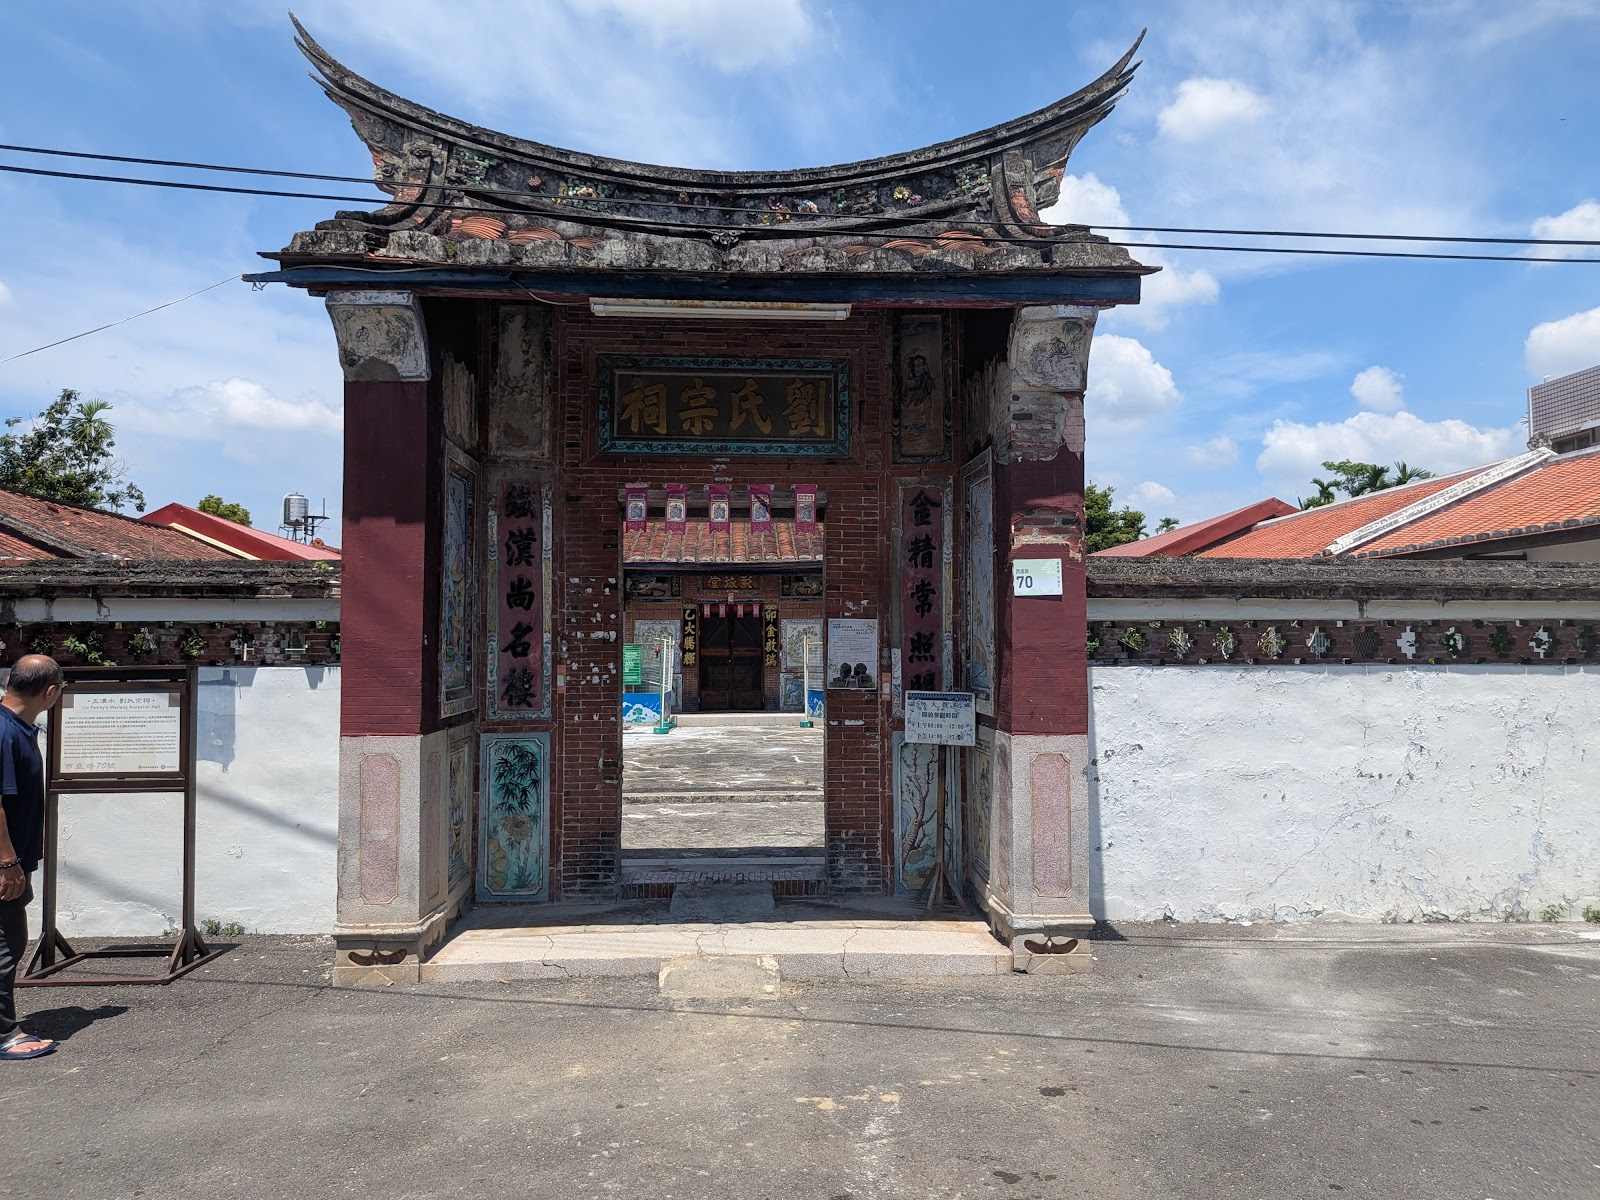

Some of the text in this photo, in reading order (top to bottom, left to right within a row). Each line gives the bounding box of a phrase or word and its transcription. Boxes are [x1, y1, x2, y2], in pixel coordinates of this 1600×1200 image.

[620, 376, 827, 437] 劉氏宗祠
[1016, 575, 1033, 589] 70
